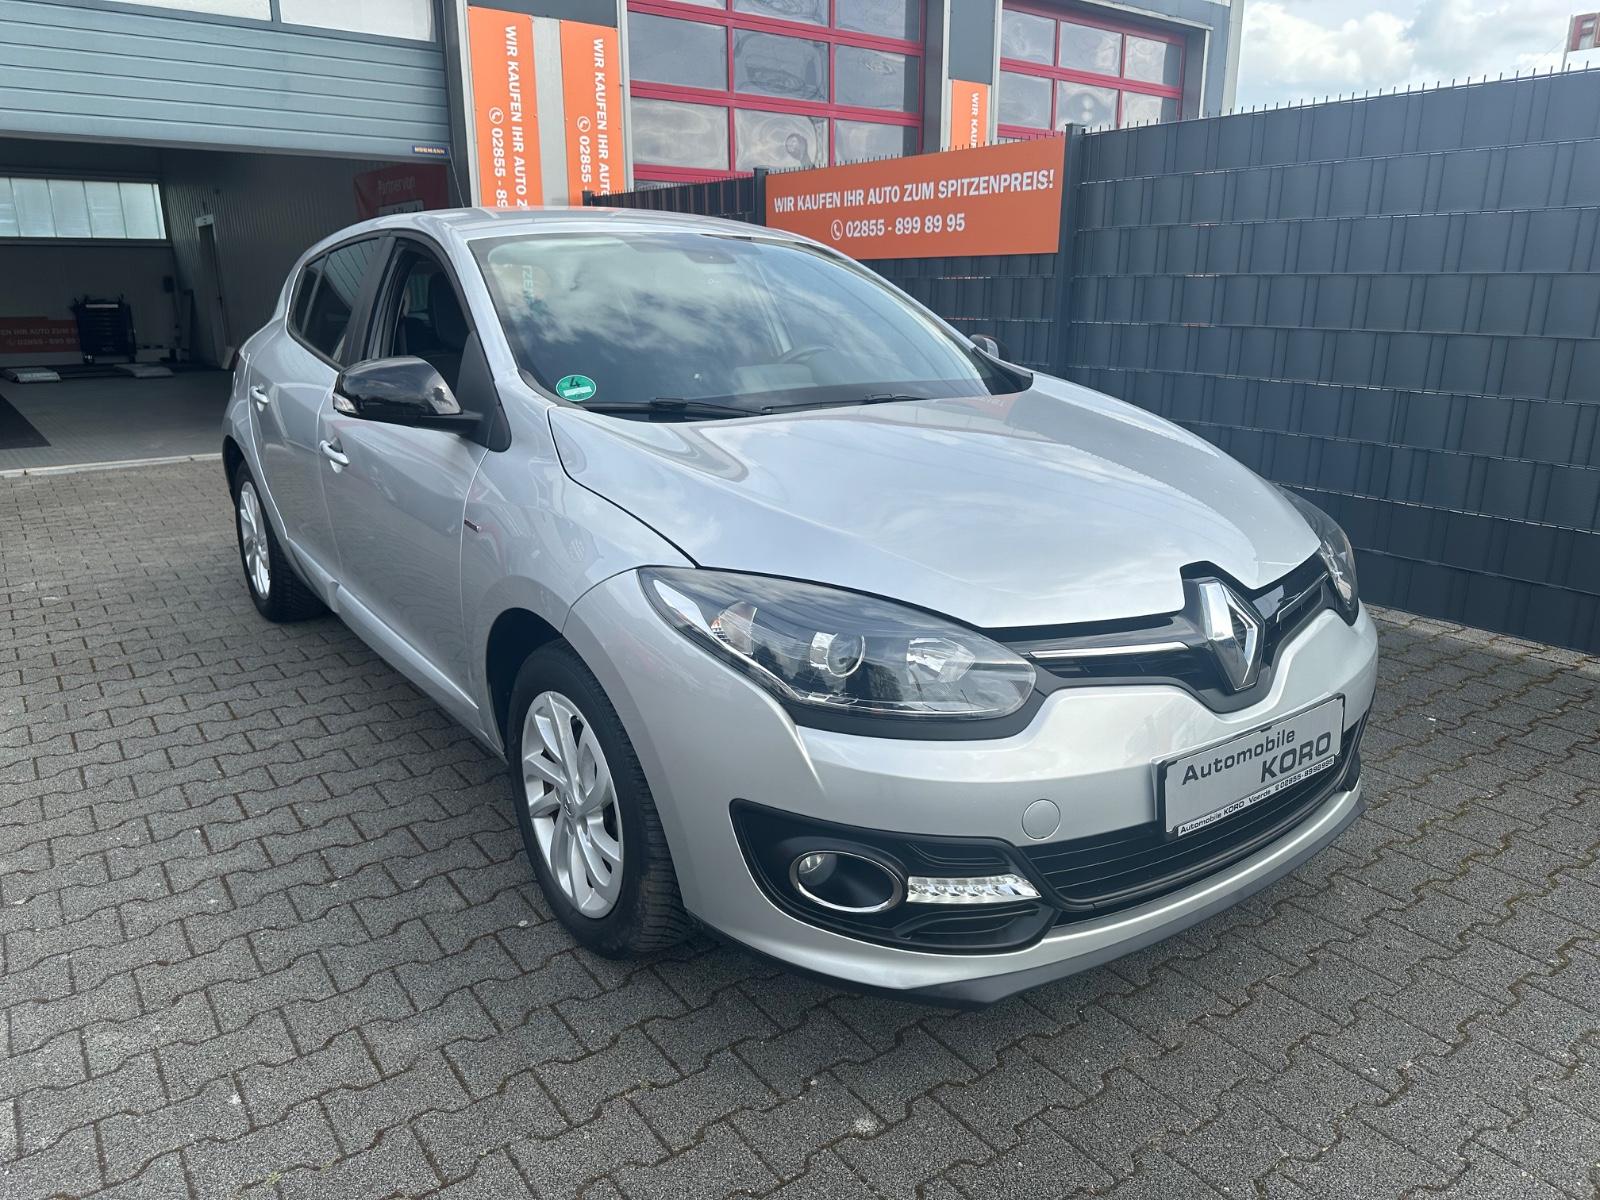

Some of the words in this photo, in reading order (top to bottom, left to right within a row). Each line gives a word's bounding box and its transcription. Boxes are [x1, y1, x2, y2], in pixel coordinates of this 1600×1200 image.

[505, 26, 518, 57] WIR
[593, 39, 604, 69] WIR
[507, 61, 523, 122] KAUFEN
[595, 72, 608, 130] KAUFEN
[971, 92, 979, 116] WIR
[491, 128, 506, 177] 02855
[511, 126, 524, 153] IHR
[598, 134, 609, 159] IHR
[513, 156, 527, 196] AUTO
[579, 135, 592, 183] 02855
[774, 196, 795, 213] WIR
[797, 191, 841, 212] KAUFEN
[843, 189, 865, 207] IHR
[867, 185, 900, 206] AUTO
[903, 181, 935, 202] ZUM
[937, 169, 1055, 199] SPITZENPREIS!
[845, 218, 885, 238] 02855
[895, 216, 921, 235] 899
[924, 214, 943, 233] 89
[946, 212, 965, 232] 95
[570, 377, 581, 387] 4
[1182, 729, 1296, 786] Automobile
[1260, 731, 1331, 784] KORO
[1180, 812, 1222, 834] Automobile
[1223, 801, 1245, 816] KORO
